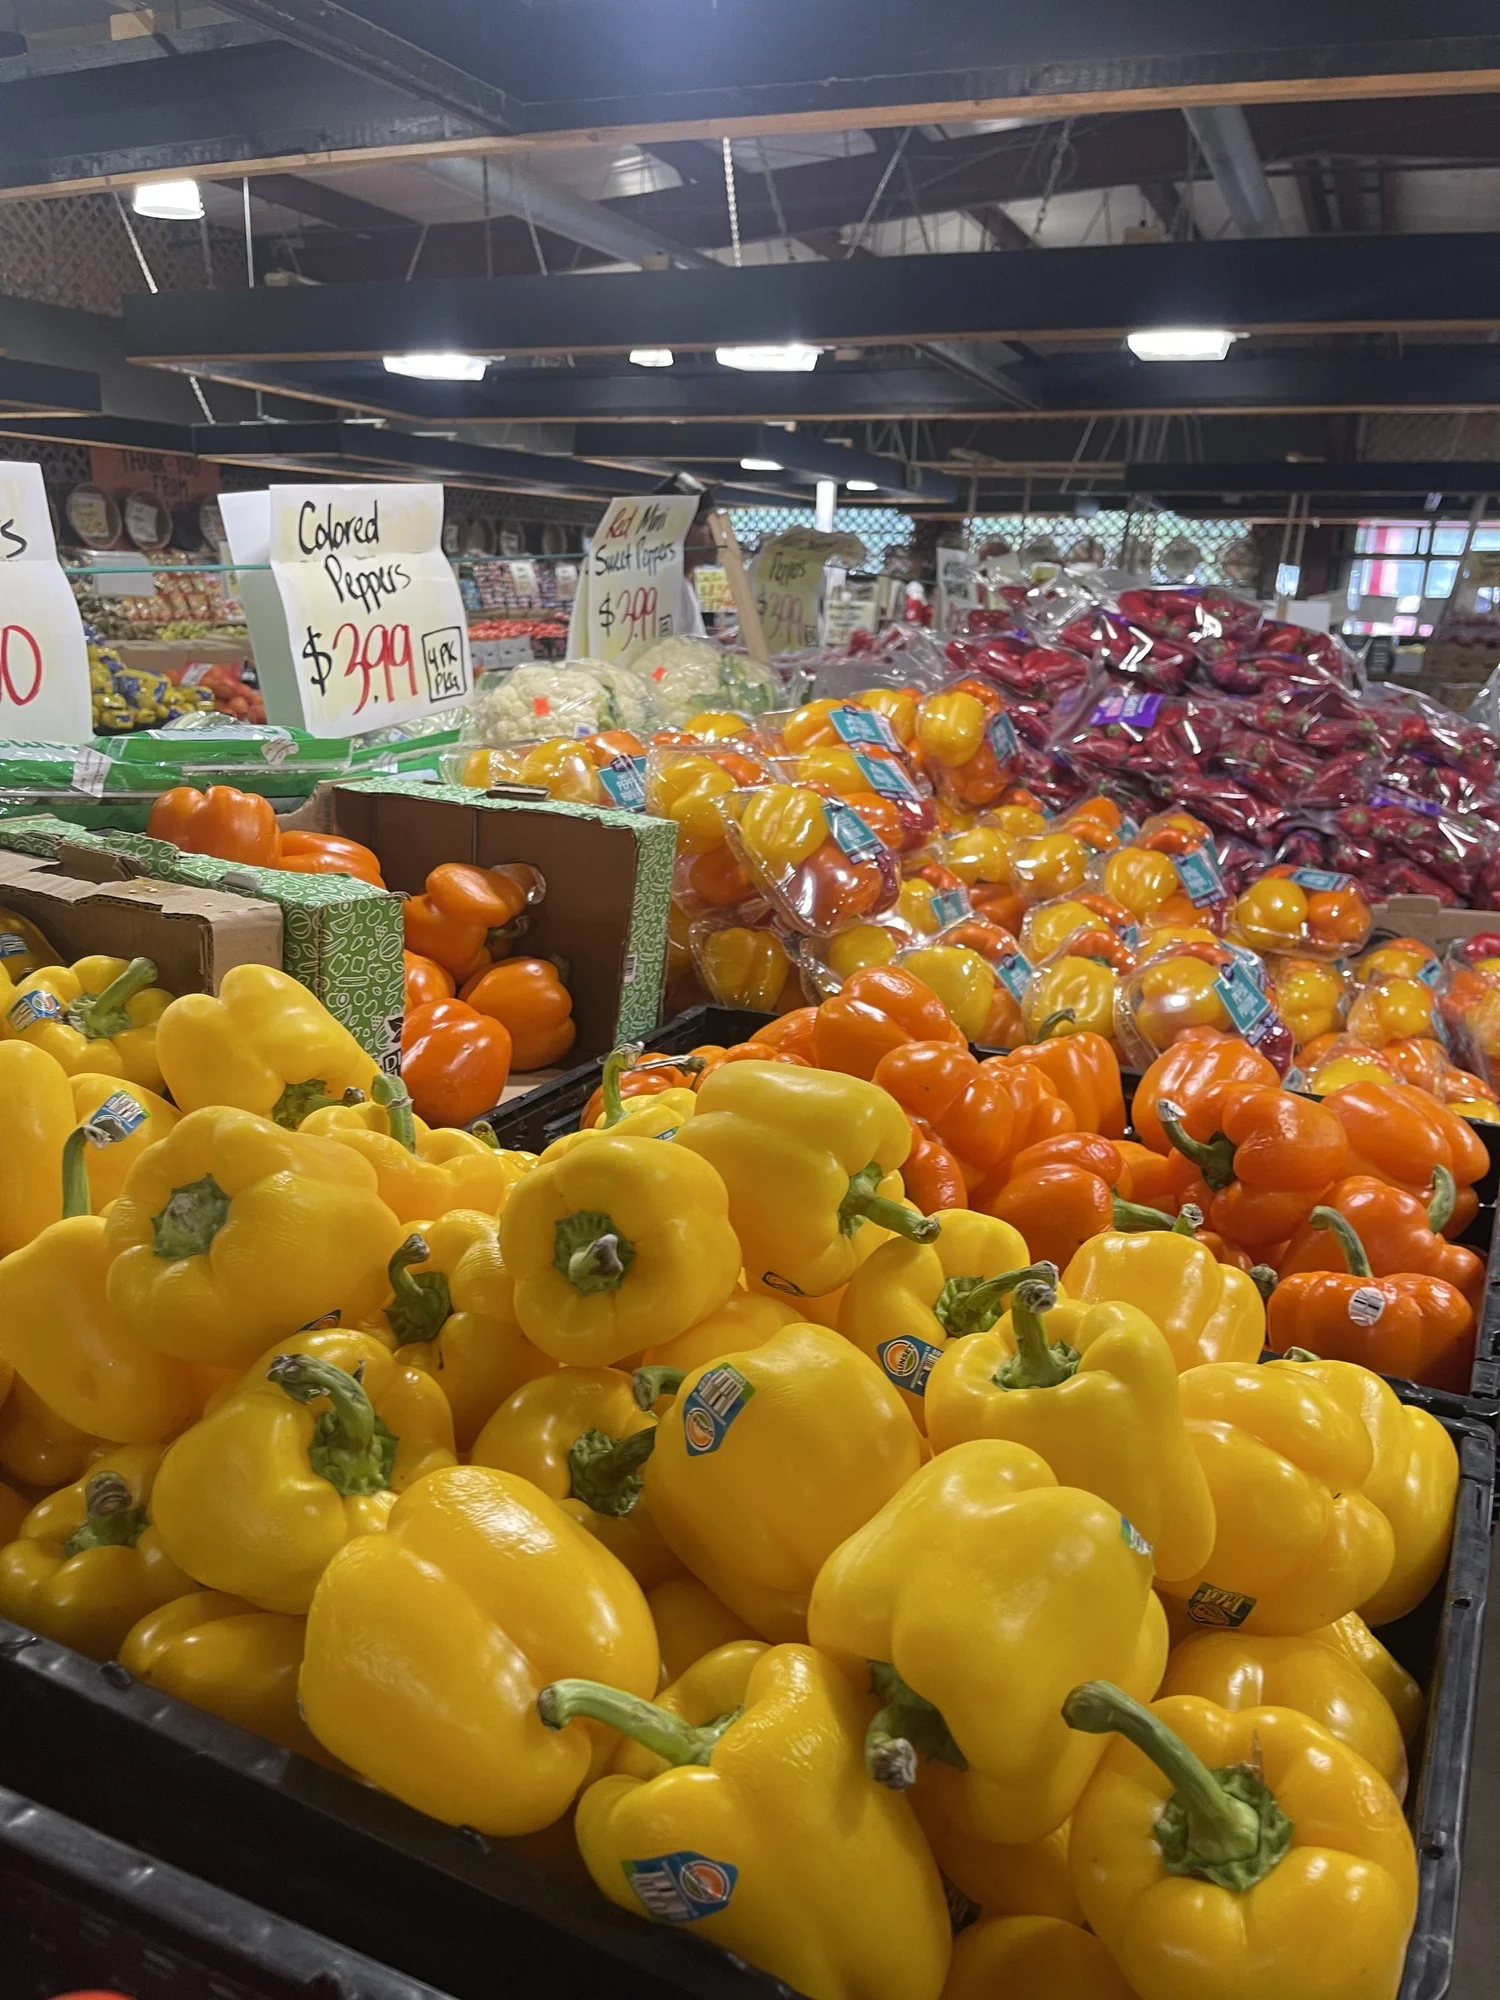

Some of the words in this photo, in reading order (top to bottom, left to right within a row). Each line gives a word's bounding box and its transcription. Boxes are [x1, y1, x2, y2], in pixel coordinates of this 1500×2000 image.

[299, 500, 380, 555] Colored
[605, 507, 639, 540] Red
[595, 544, 631, 576] Sweet
[636, 535, 677, 577] Peppers
[324, 554, 411, 615] Peppers
[0, 624, 42, 706] 0
[896, 1343, 915, 1376] SUNSET
